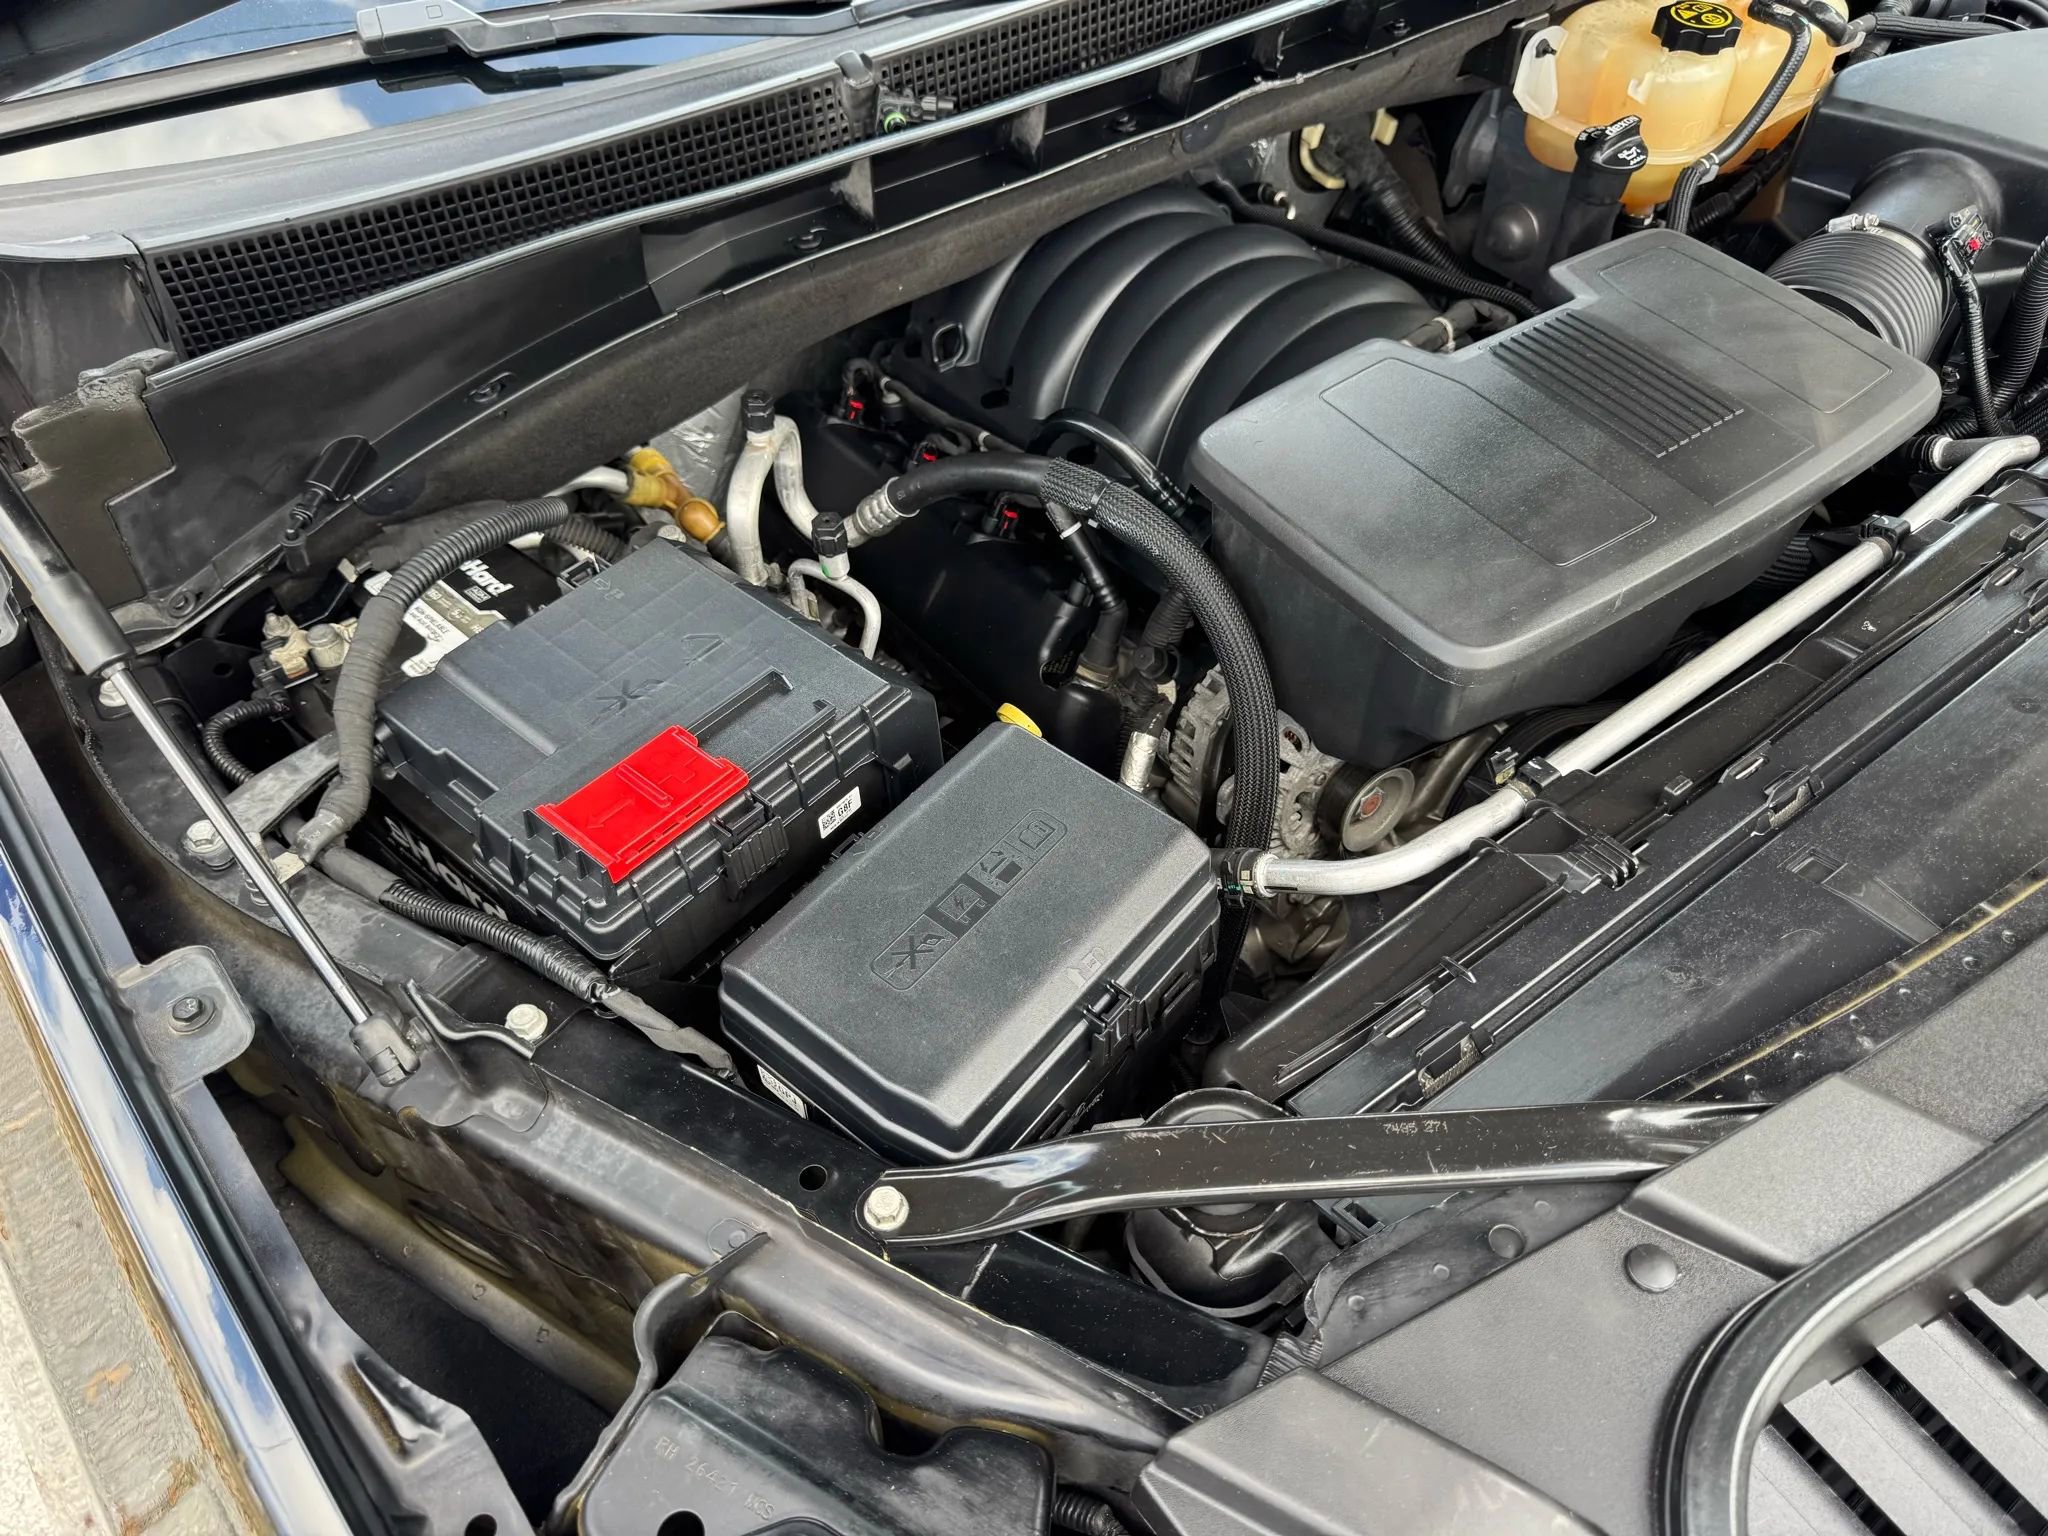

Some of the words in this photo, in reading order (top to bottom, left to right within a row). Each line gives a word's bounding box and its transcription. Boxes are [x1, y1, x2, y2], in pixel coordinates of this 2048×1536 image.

[459, 559, 514, 597] Hard
[837, 799, 853, 817] G8F
[654, 1436, 681, 1460] RH
